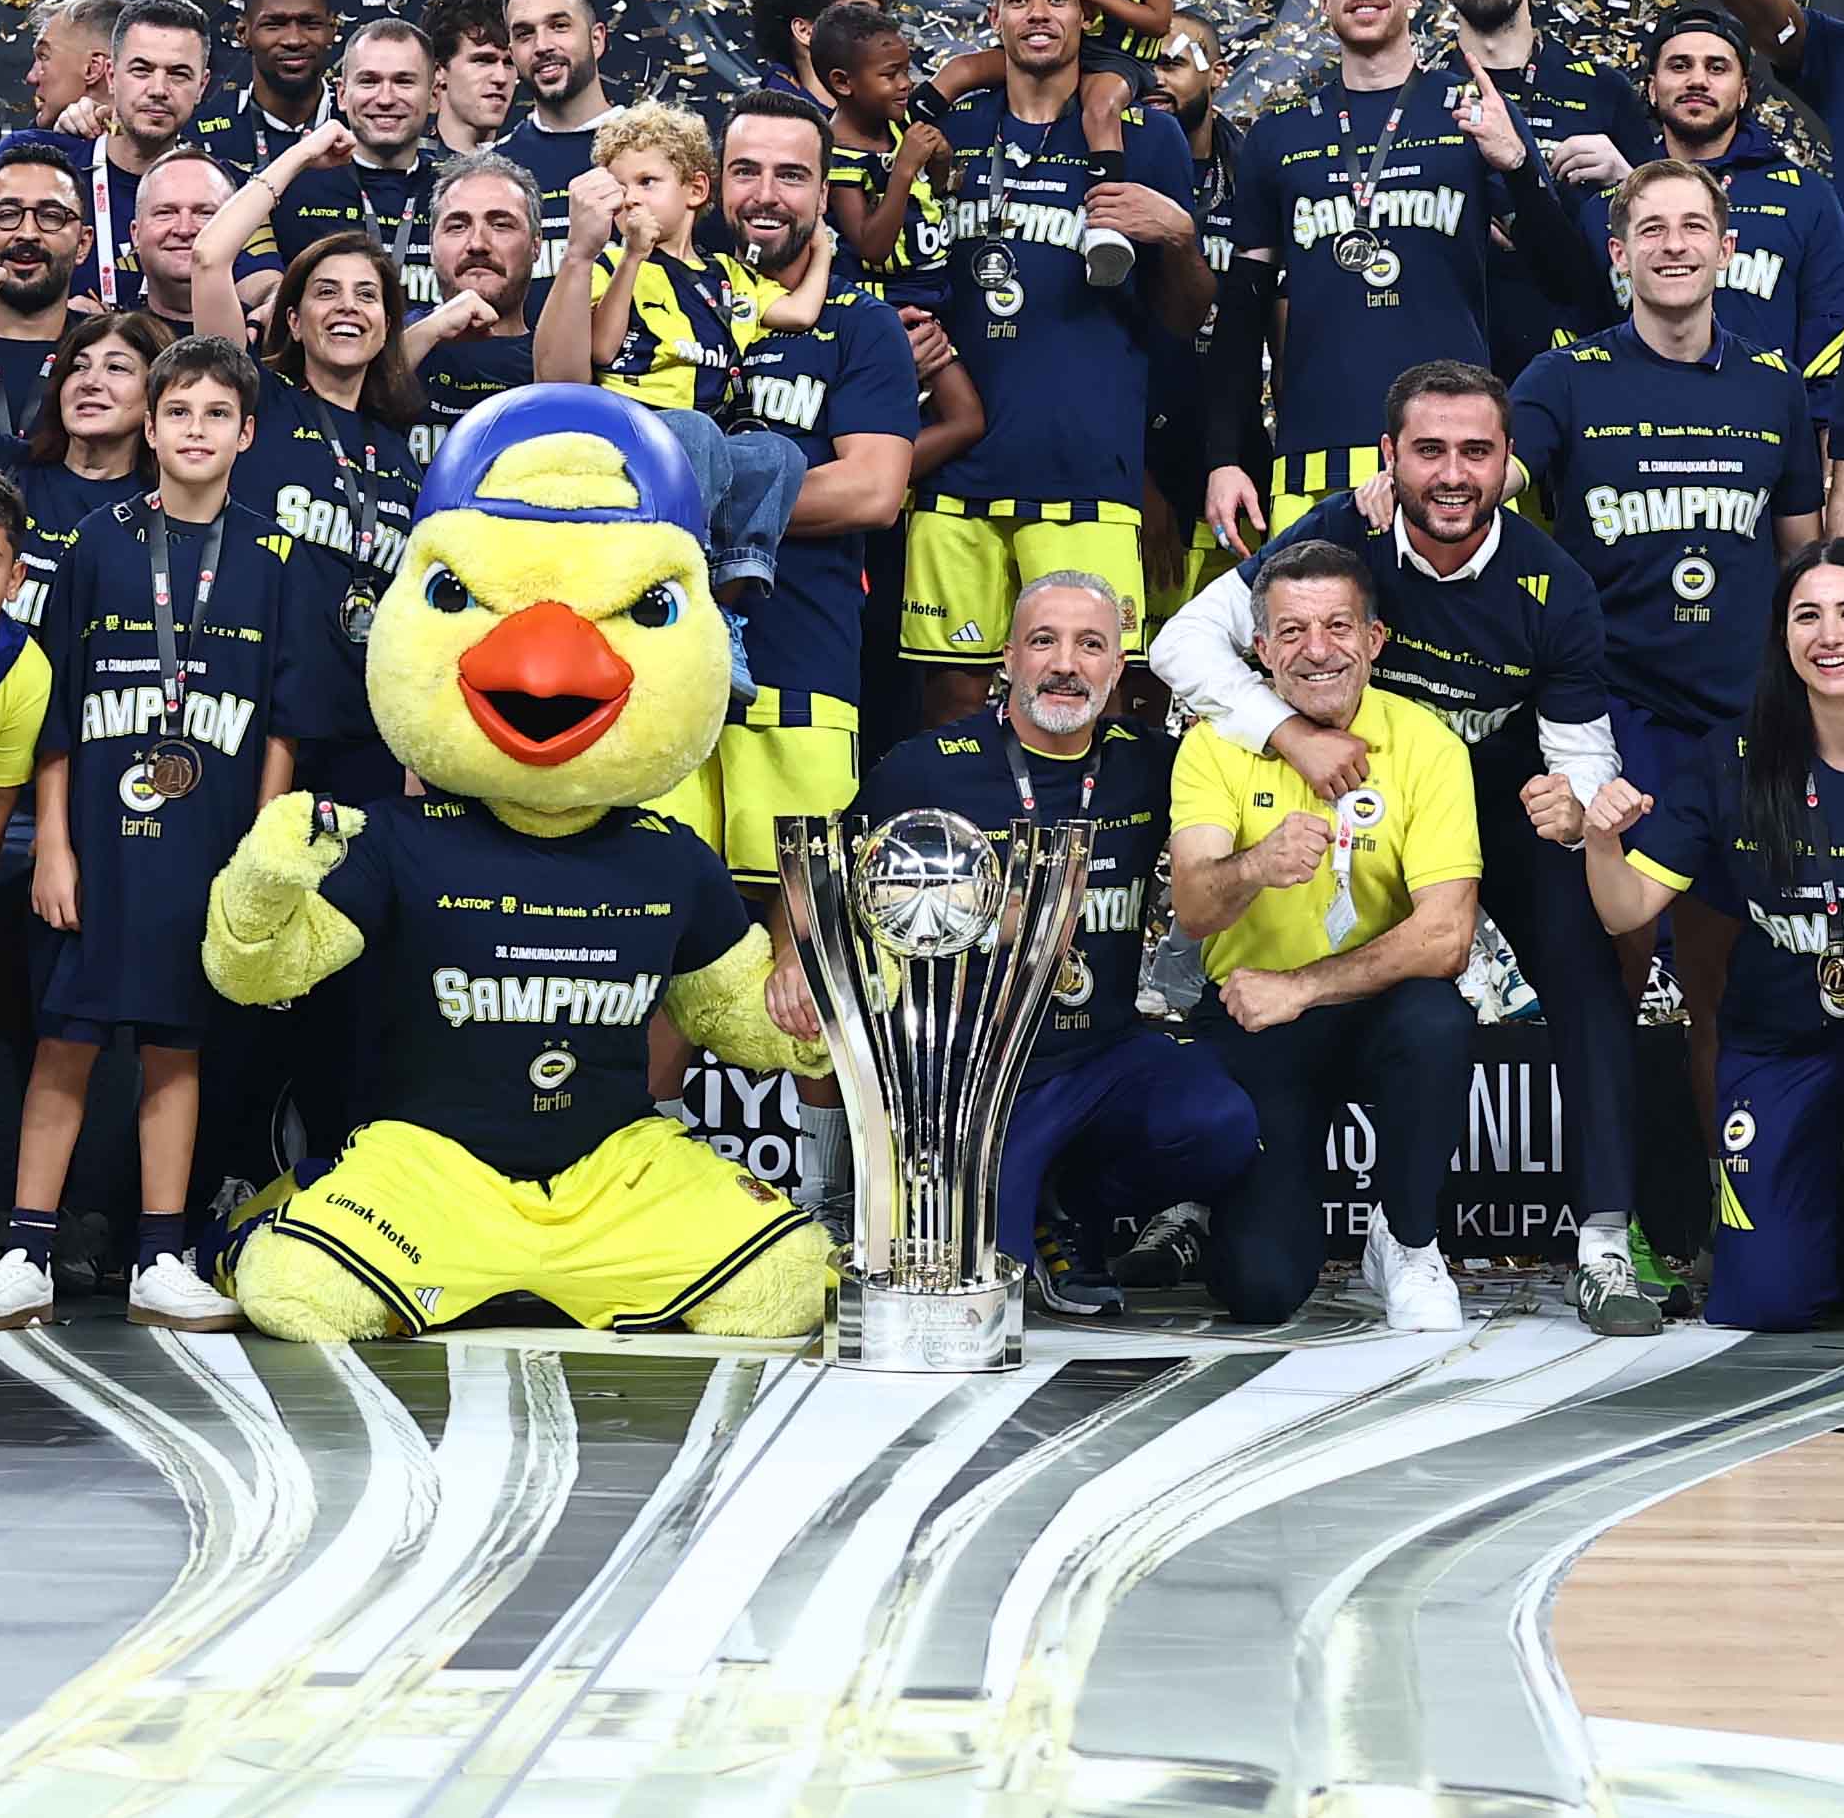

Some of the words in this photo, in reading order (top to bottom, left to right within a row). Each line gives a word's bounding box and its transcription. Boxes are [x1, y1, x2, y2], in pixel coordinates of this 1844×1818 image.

[198, 117, 230, 133] tarfin
[1293, 149, 1320, 161] ASTOR
[1396, 137, 1435, 149] BİLFEN
[311, 209, 339, 218] ASTOR
[1367, 290, 1400, 308] tarfin
[987, 321, 1017, 339] tarfin
[1572, 347, 1611, 363] tarfin
[1599, 426, 1633, 437] ASTOR
[1657, 425, 1685, 436] Limak
[1687, 426, 1713, 437] Hotels
[1719, 461, 1743, 473] KUPASI
[910, 601, 949, 618] Hotels
[1674, 604, 1710, 623] tarfin
[124, 620, 154, 631] Limak
[1425, 642, 1451, 660] Hotels
[81, 687, 255, 756] AMPYON
[938, 737, 981, 755] tarfin
[423, 802, 465, 818] tarfin
[122, 816, 161, 838] tarfin
[454, 898, 491, 910] ASTOR
[523, 903, 554, 916] Limak
[556, 905, 587, 918] Hotels
[592, 903, 640, 917] BİLFEN
[495, 946, 509, 959] 39.
[510, 946, 589, 962] CUMHURBAŞKANLIĞI
[590, 949, 617, 962] KUPASI
[433, 968, 661, 1027] ŞAMPİYON
[1055, 1011, 1090, 1030] tarfin
[533, 1092, 571, 1113] tarfin
[325, 1193, 376, 1224] Limak
[377, 1219, 422, 1265] Hotels
[1457, 1203, 1579, 1237] KUPA
